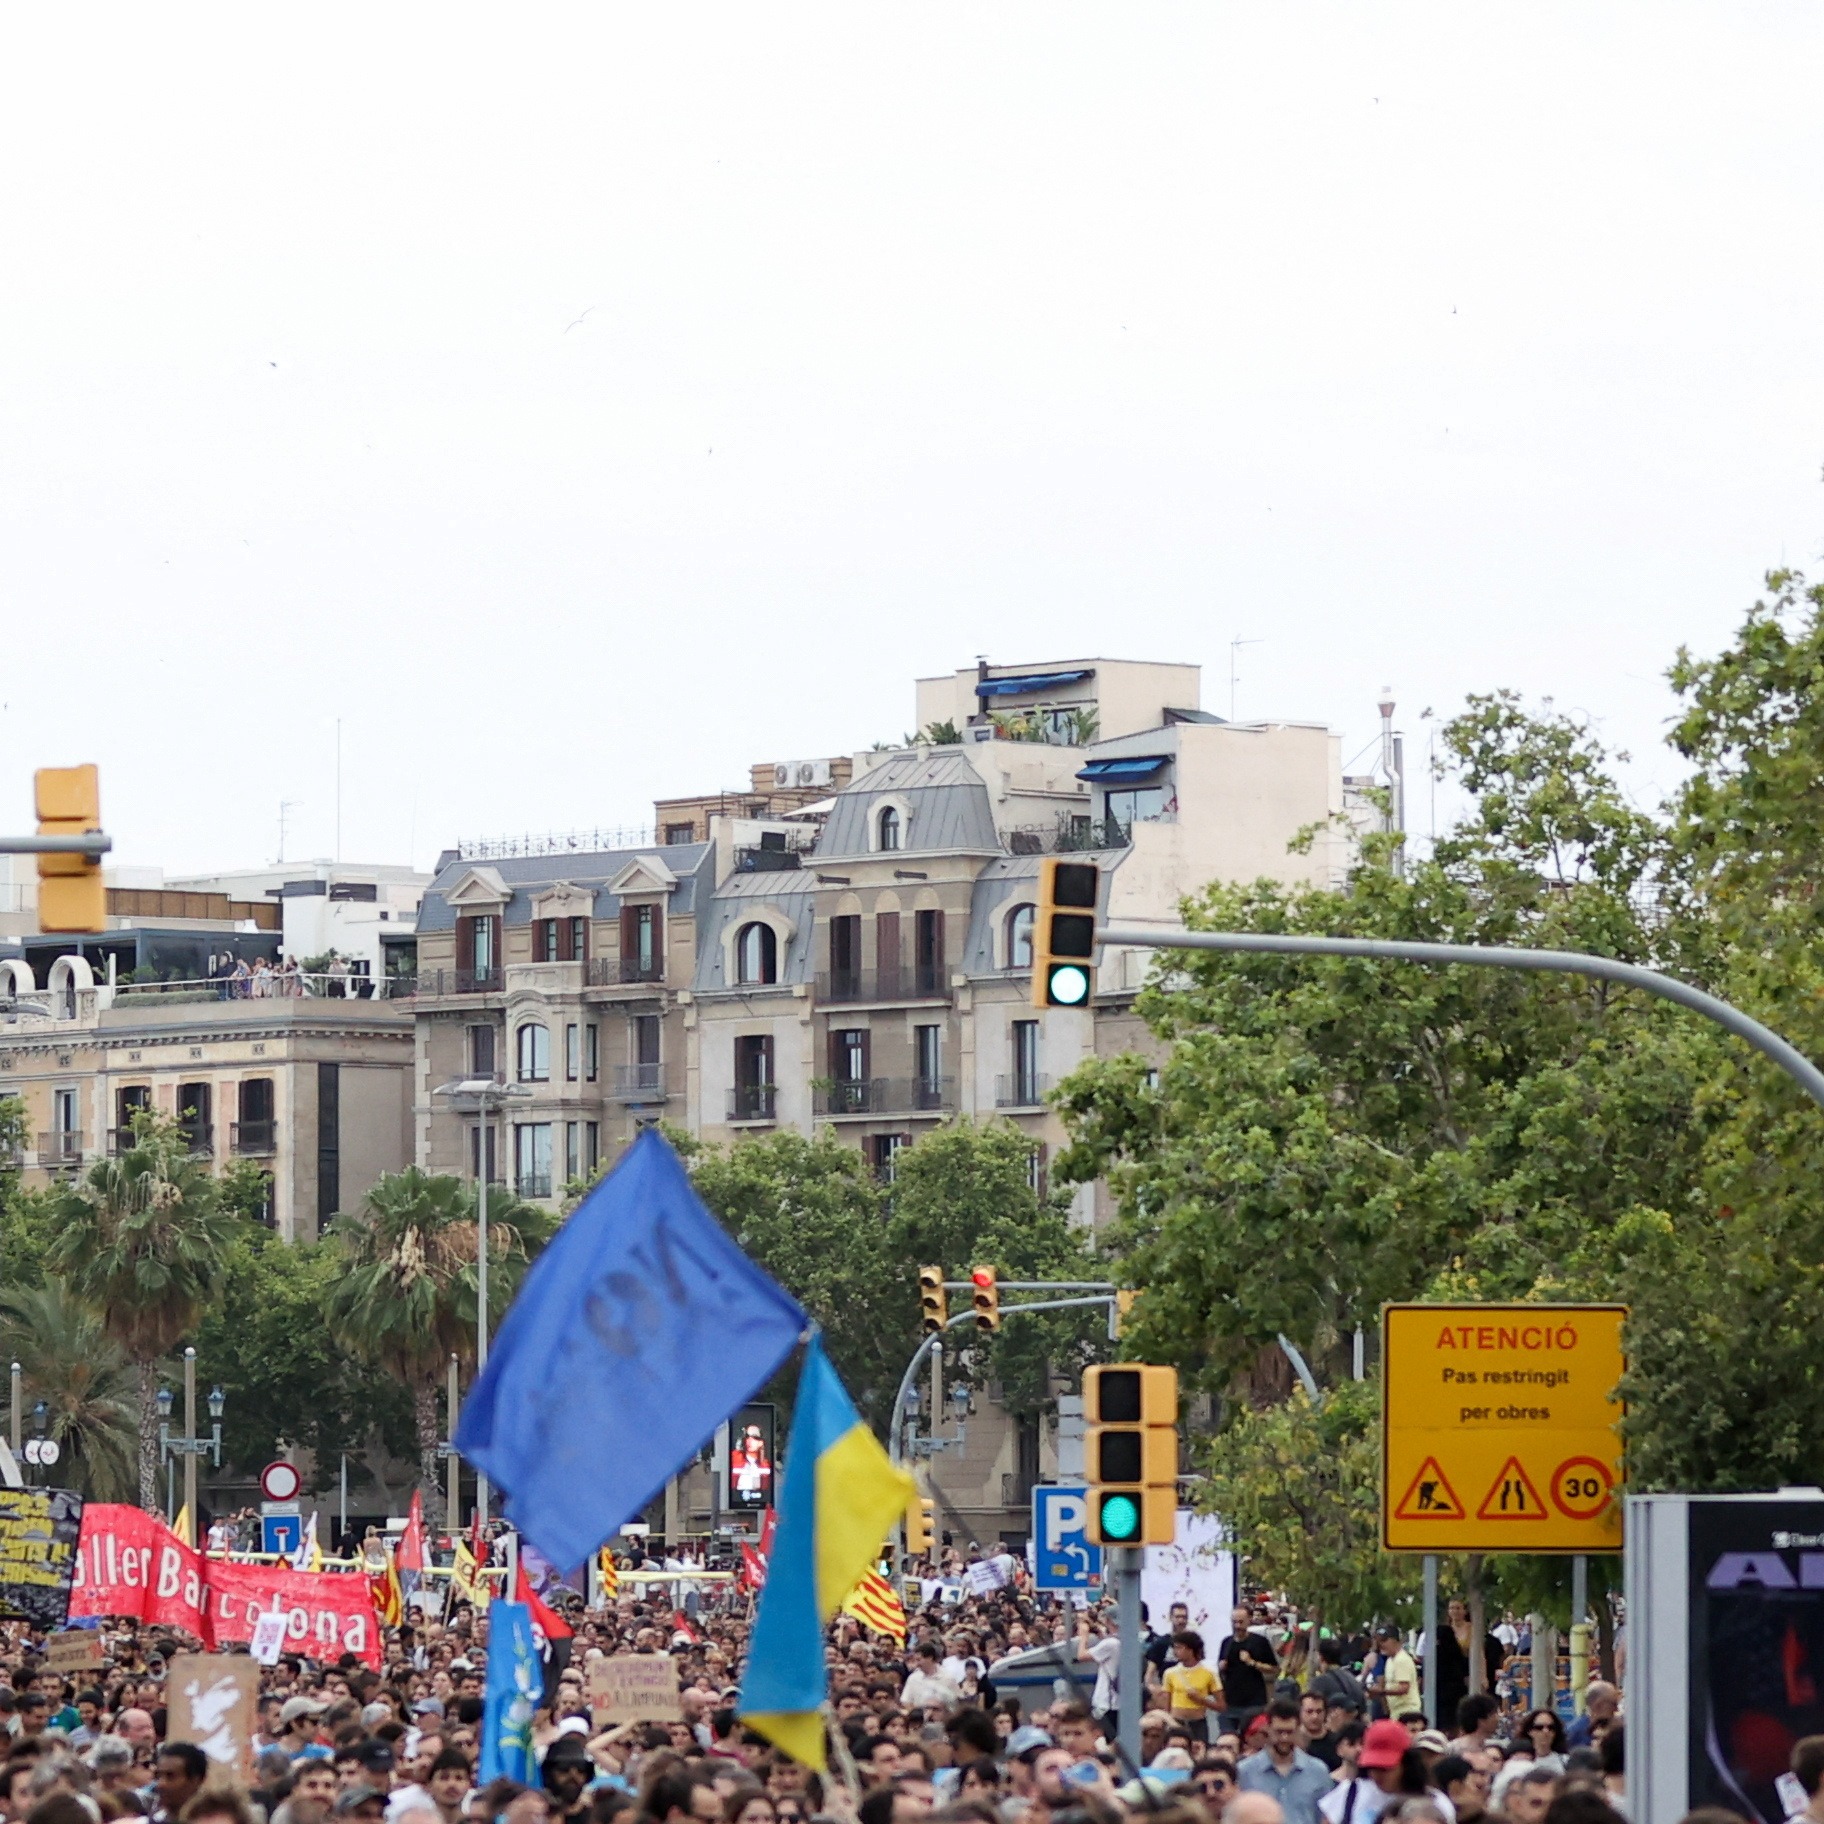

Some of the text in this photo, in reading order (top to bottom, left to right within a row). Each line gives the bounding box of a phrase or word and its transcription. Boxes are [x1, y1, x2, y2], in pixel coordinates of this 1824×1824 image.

[1436, 1321, 1578, 1350] ATENCIÓ
[1442, 1368, 1570, 1388] Pas restringit
[1460, 1404, 1551, 1423] per obres
[1565, 1478, 1600, 1498] 30
[1046, 1495, 1087, 1551] P
[71, 1533, 152, 1588] aller
